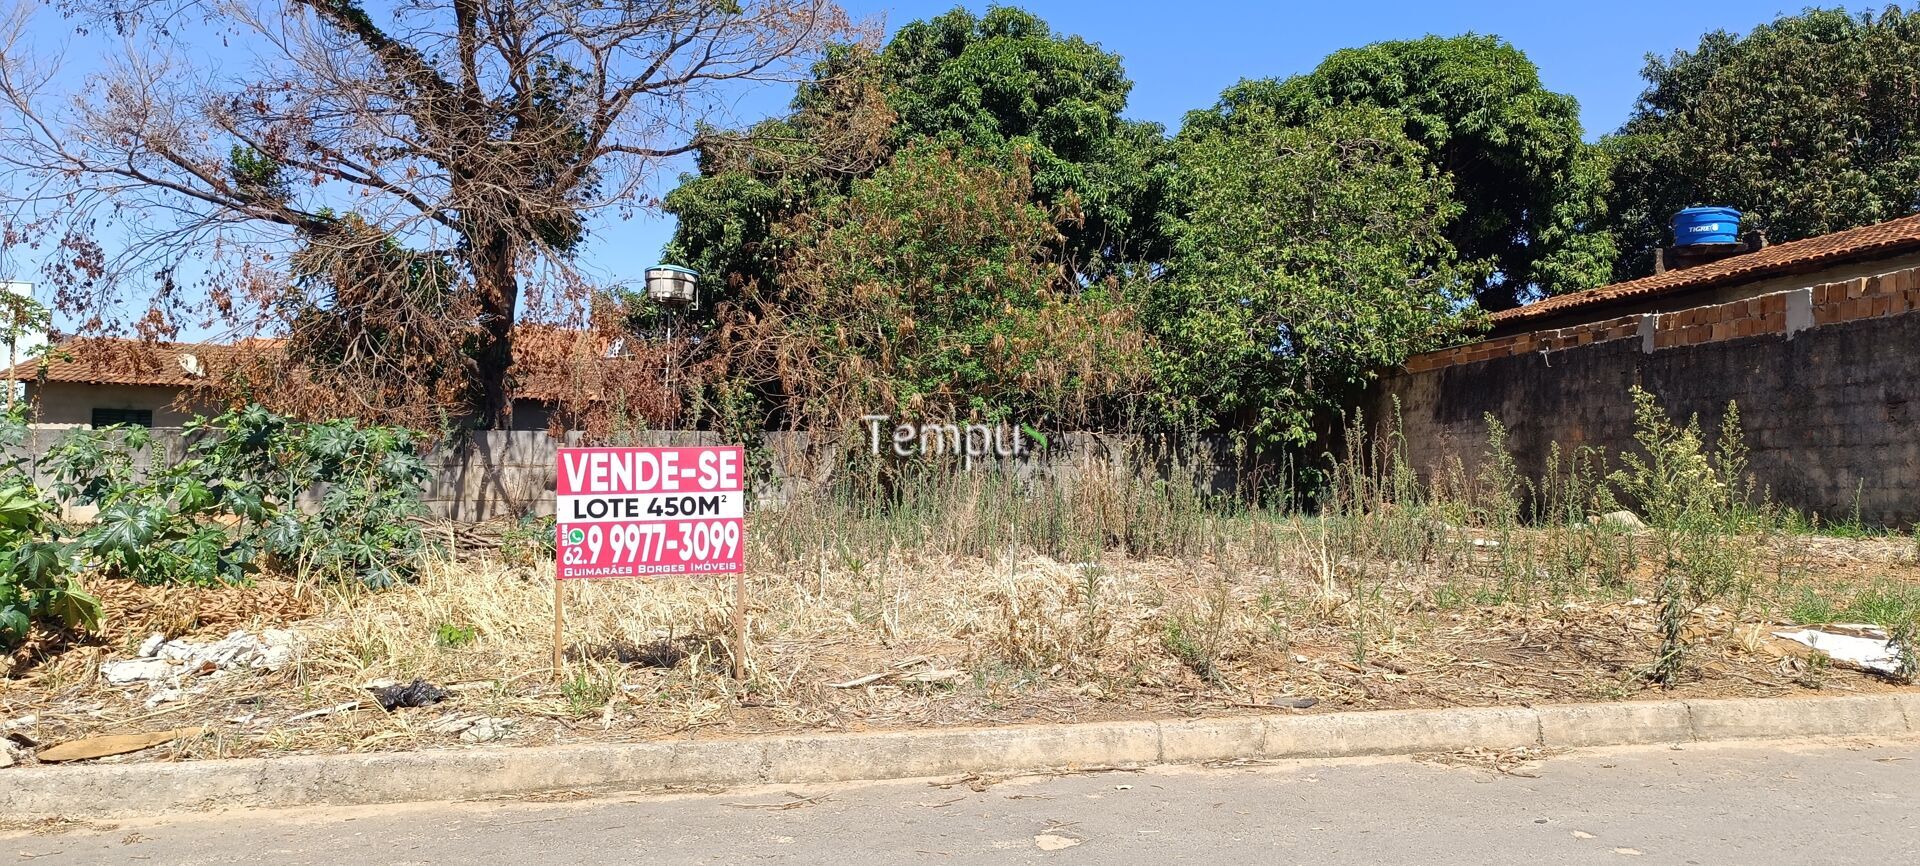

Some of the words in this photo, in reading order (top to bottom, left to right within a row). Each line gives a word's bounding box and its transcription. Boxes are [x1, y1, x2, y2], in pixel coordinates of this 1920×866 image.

[563, 450, 738, 492] VENDE-SE
[573, 498, 639, 519] LOTE
[609, 521, 739, 563] 9977-3099
